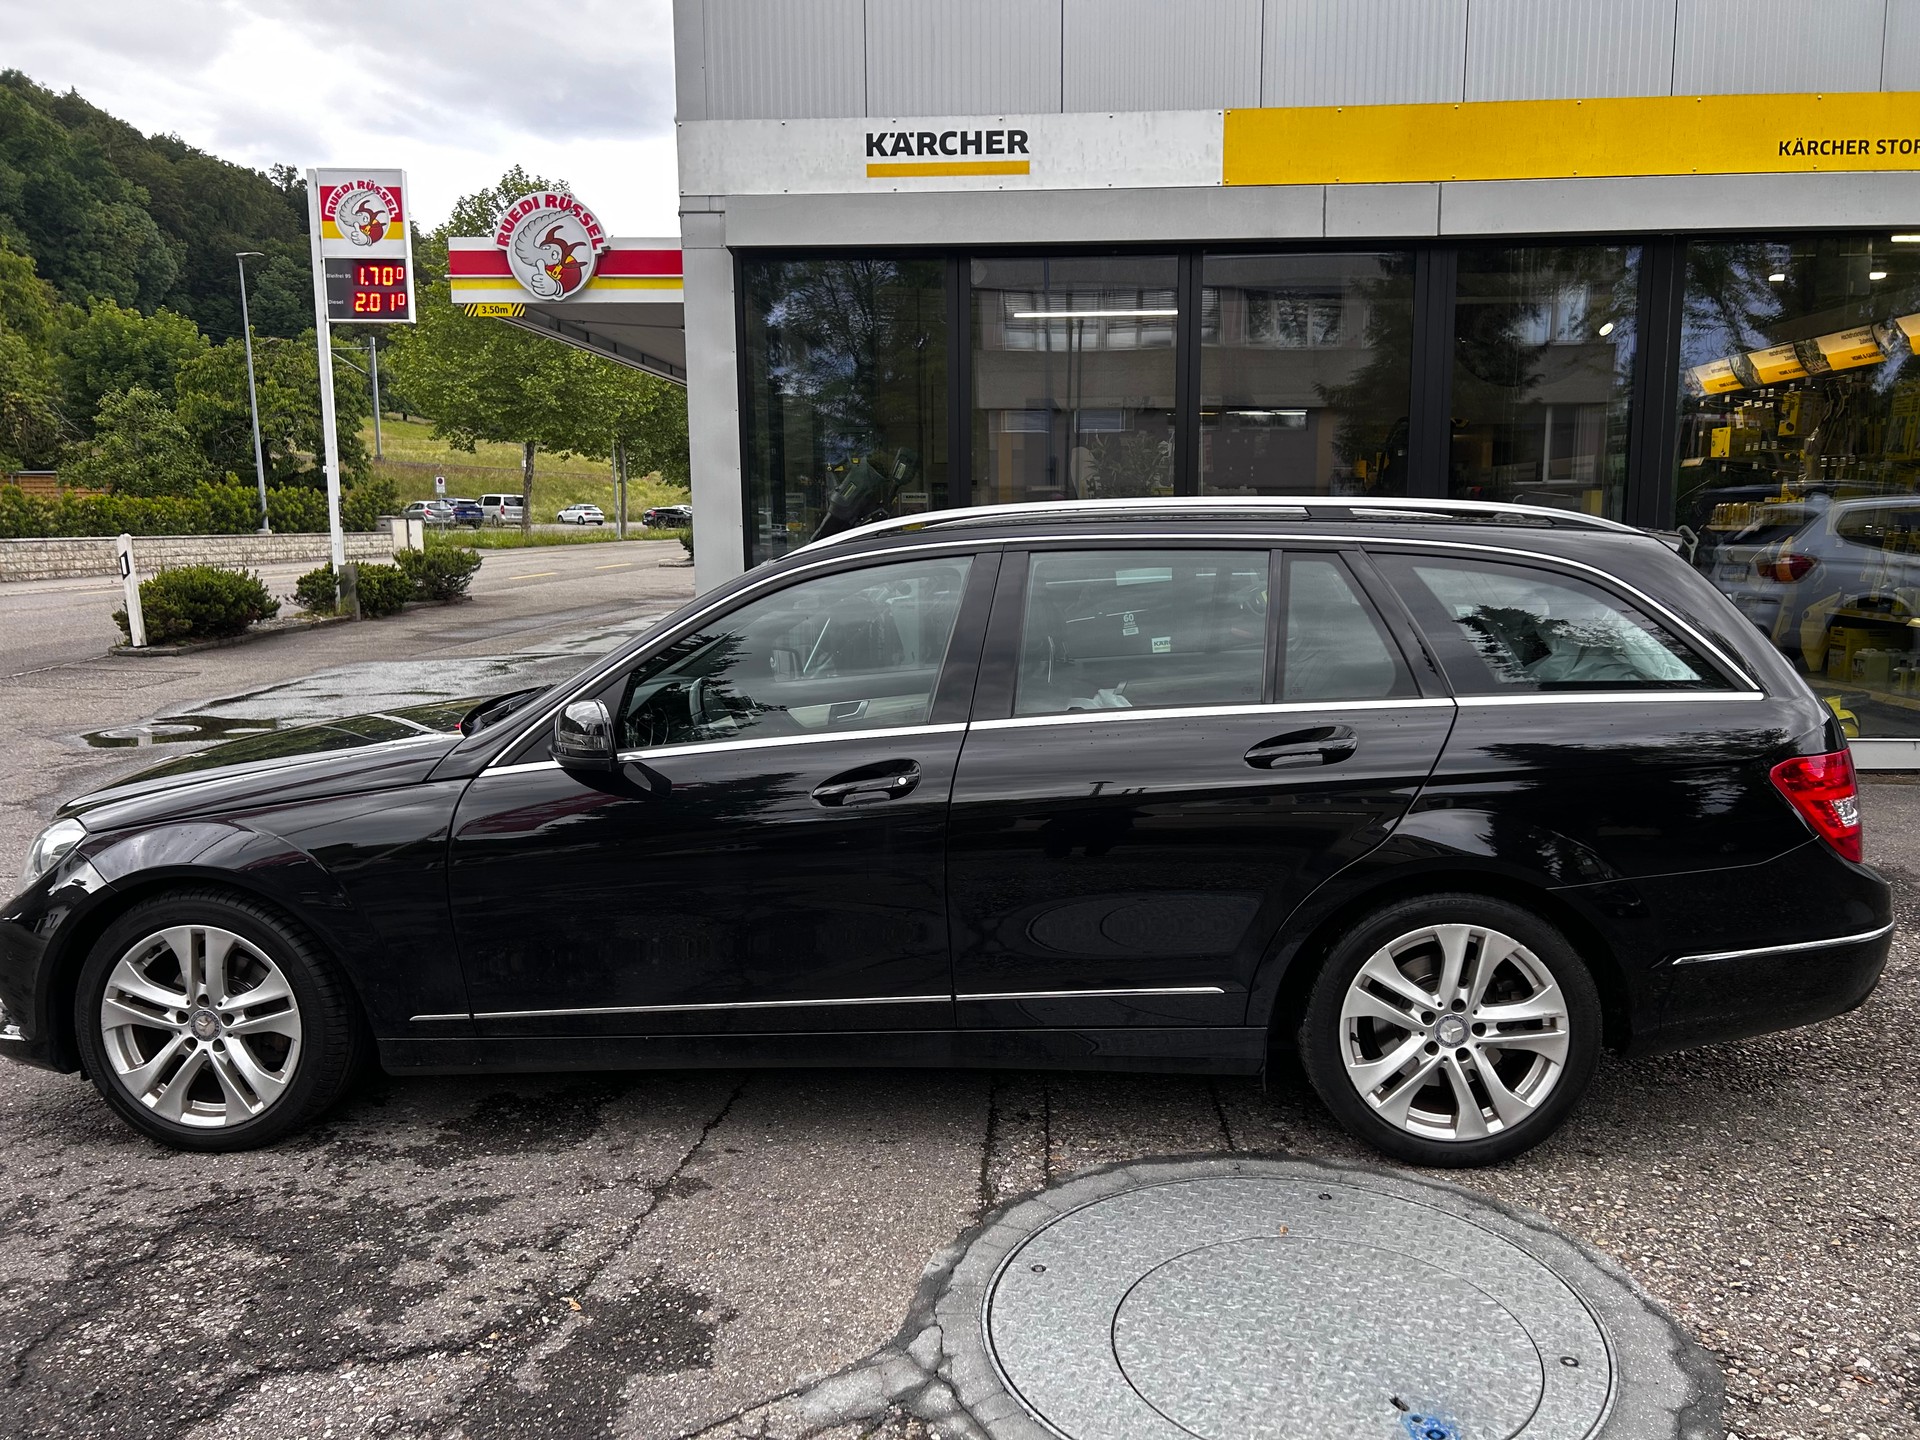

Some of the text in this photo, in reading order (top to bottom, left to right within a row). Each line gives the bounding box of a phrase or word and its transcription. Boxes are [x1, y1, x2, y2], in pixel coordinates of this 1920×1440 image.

[866, 129, 1030, 157] KÄRCHER
[1778, 137, 1870, 156] KÄRCHER
[326, 179, 399, 218] RUEDI RÜSSEL
[496, 193, 605, 251] RUEDI RÜSSEL
